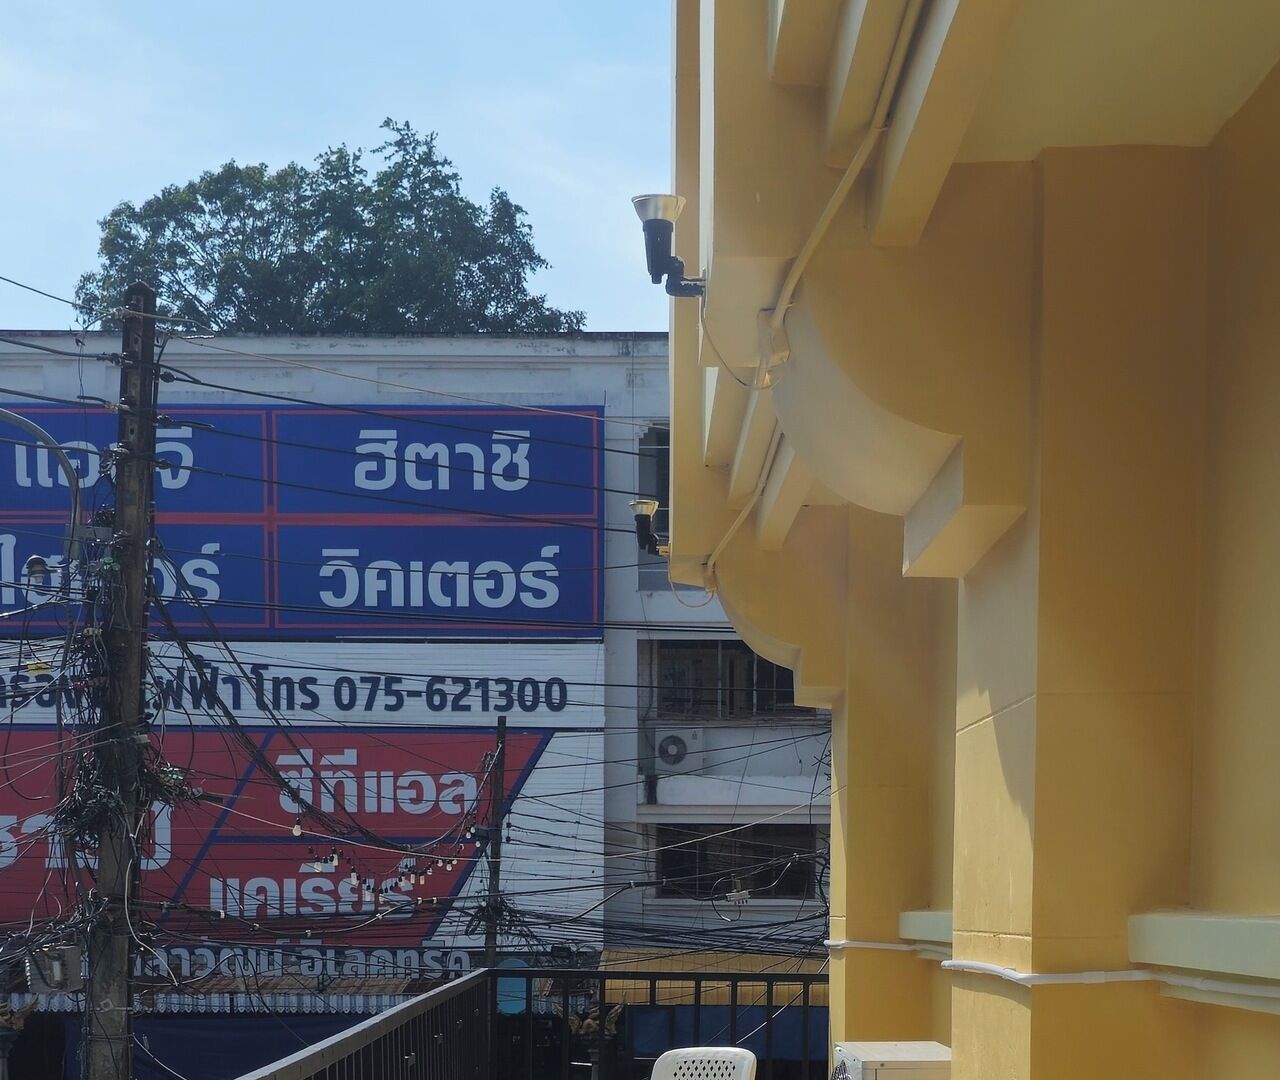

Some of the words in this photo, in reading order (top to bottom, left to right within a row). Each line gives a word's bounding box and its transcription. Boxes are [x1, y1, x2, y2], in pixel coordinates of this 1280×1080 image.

[14, 427, 194, 489] แอจี
[354, 429, 531, 491] ฮิตาชิ
[319, 545, 560, 609] วิคเตอร์
[333, 676, 567, 712] 075-621300
